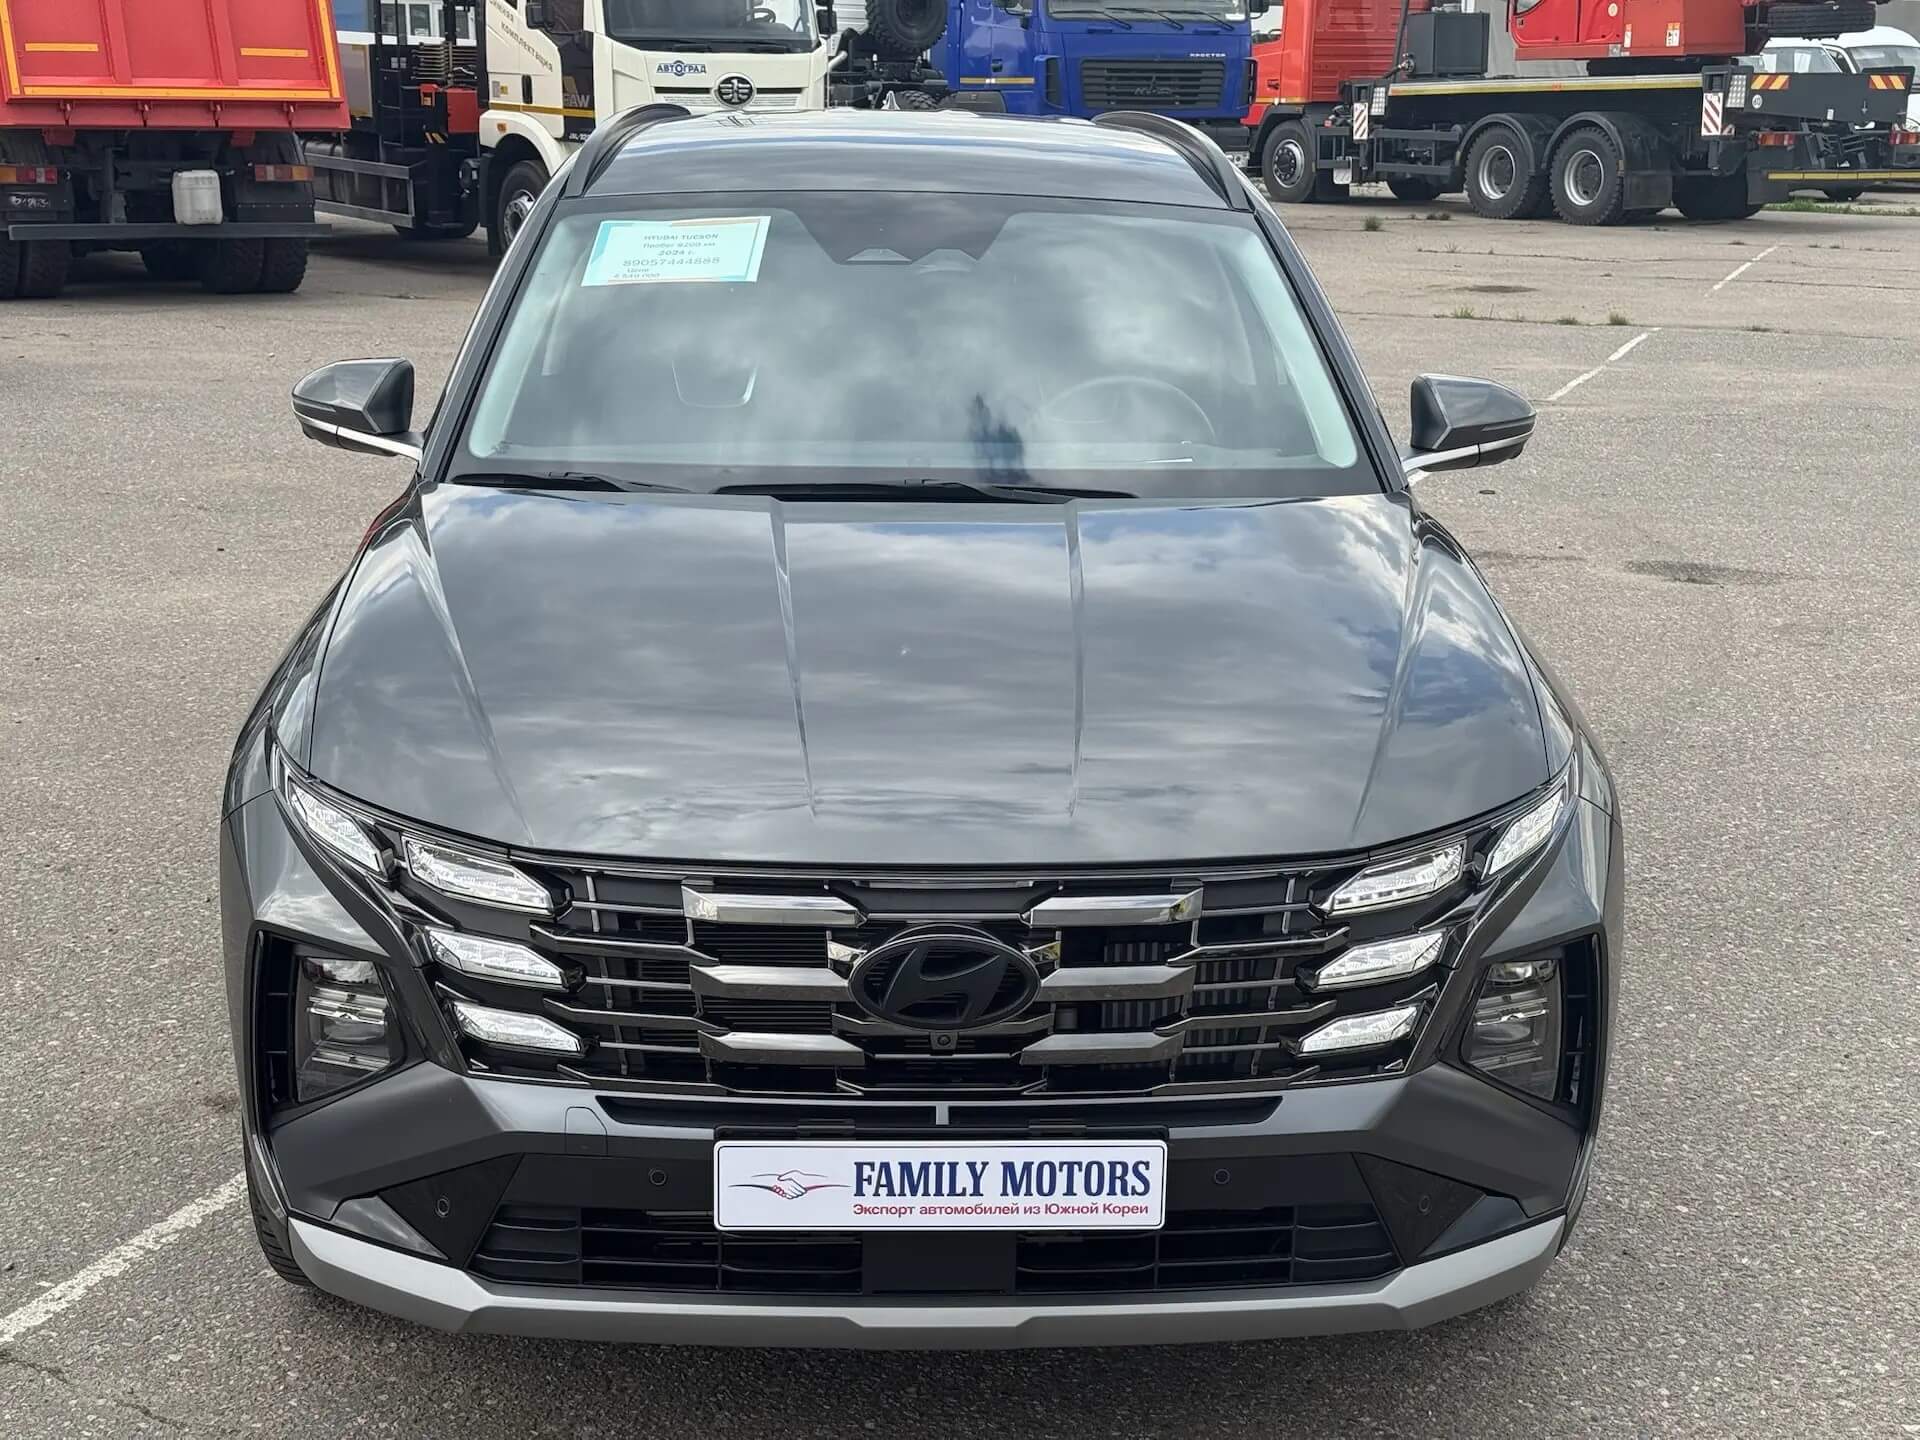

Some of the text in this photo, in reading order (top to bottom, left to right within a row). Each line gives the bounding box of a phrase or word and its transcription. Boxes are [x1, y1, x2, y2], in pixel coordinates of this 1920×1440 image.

[656, 62, 707, 74] АВТОГРАД
[681, 232, 720, 240] TUCSON
[853, 1160, 1150, 1197] FAMILY MOTORS
[853, 1202, 1149, 1218] Экспорт автомобилей из Южной Кореи
